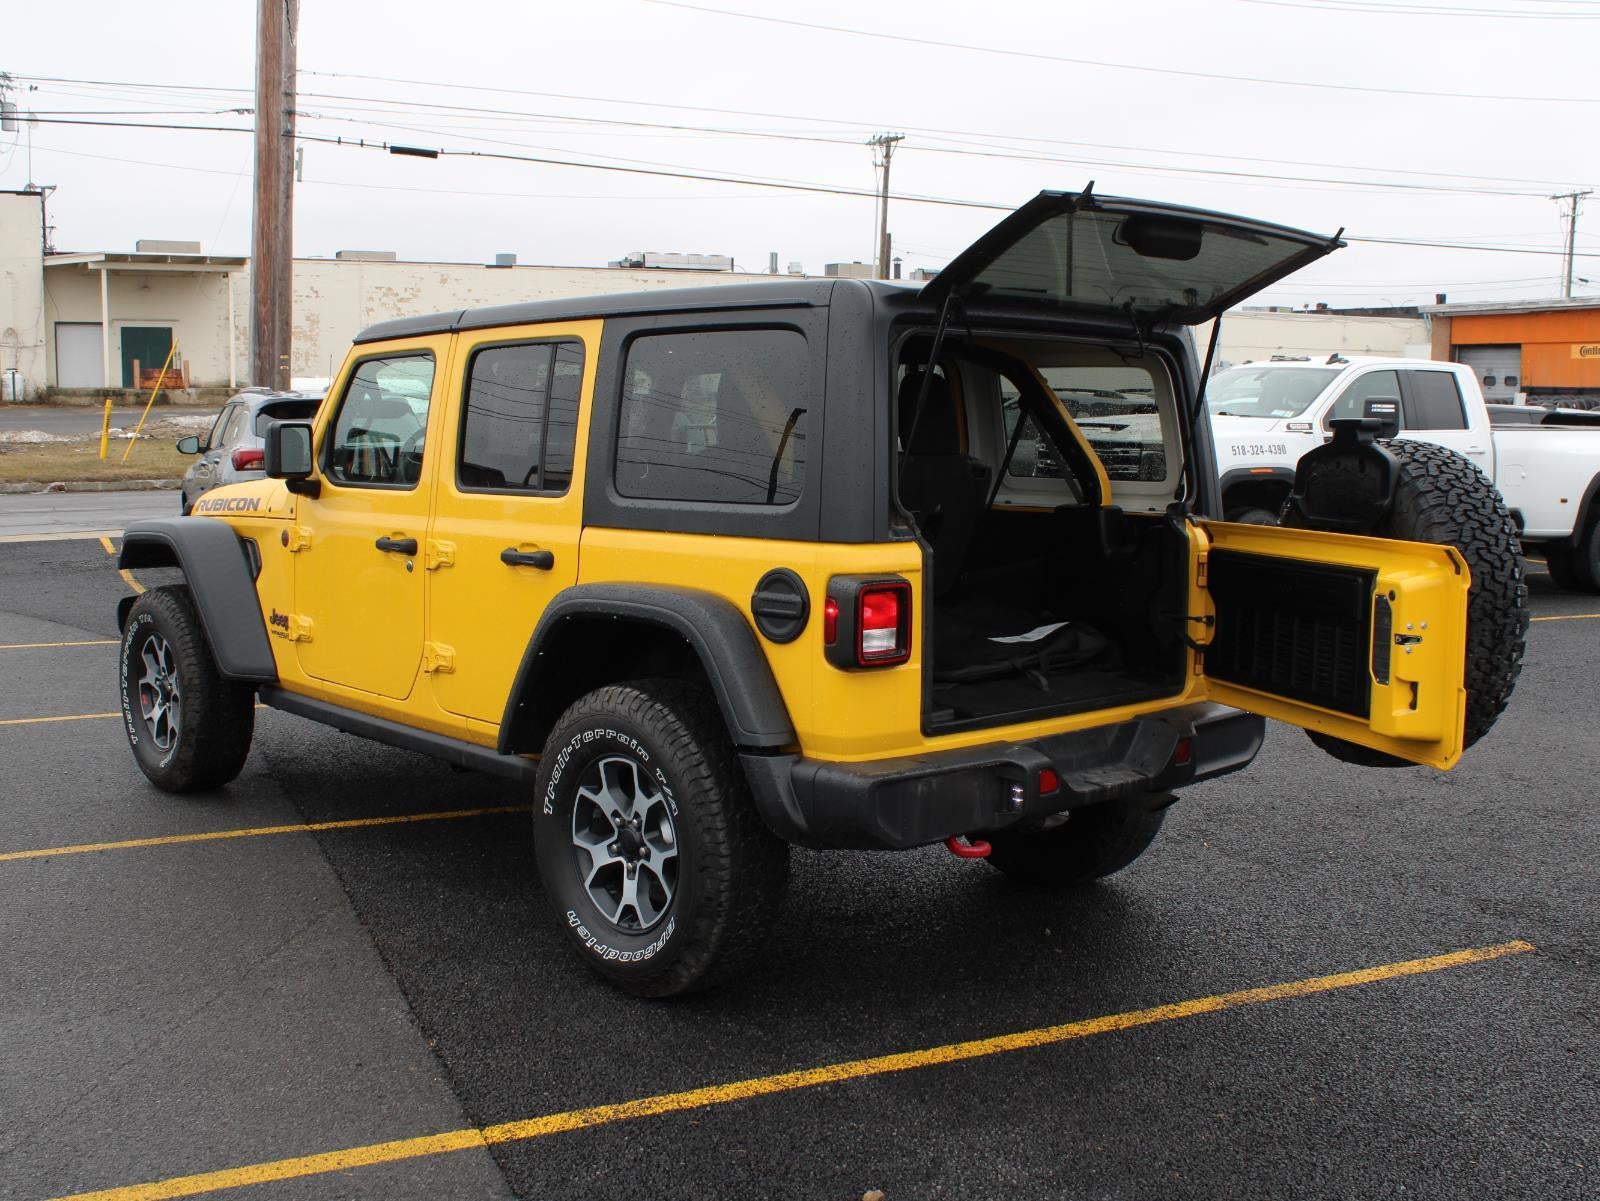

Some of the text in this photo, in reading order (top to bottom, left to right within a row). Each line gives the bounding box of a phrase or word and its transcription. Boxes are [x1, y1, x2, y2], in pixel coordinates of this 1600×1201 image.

[1231, 445, 1287, 456] 518-324-4390
[196, 498, 261, 512] RUBICON
[269, 608, 289, 631] Jeep
[543, 728, 678, 817] Trail-Terrain T/A
[567, 910, 675, 962] BFGoodrich
